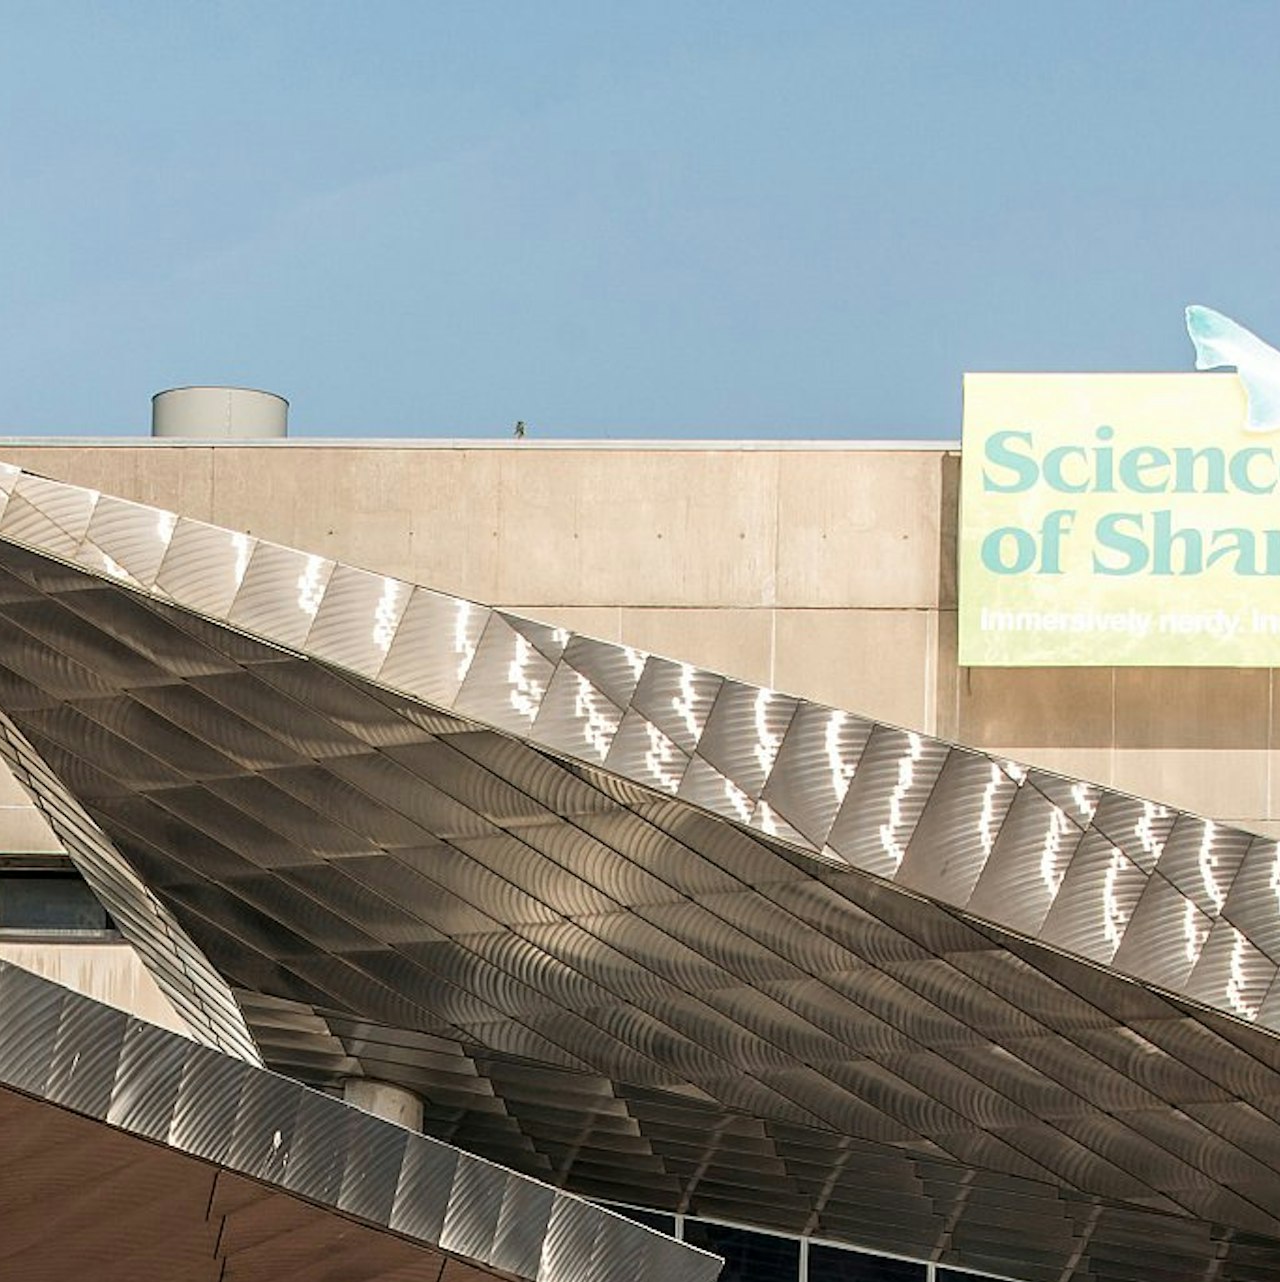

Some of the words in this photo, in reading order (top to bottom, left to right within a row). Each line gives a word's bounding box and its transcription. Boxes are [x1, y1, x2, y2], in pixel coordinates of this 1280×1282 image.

[980, 509, 1076, 575] of
[981, 607, 1150, 637] Immersively
[1159, 609, 1246, 638] nerdy.
